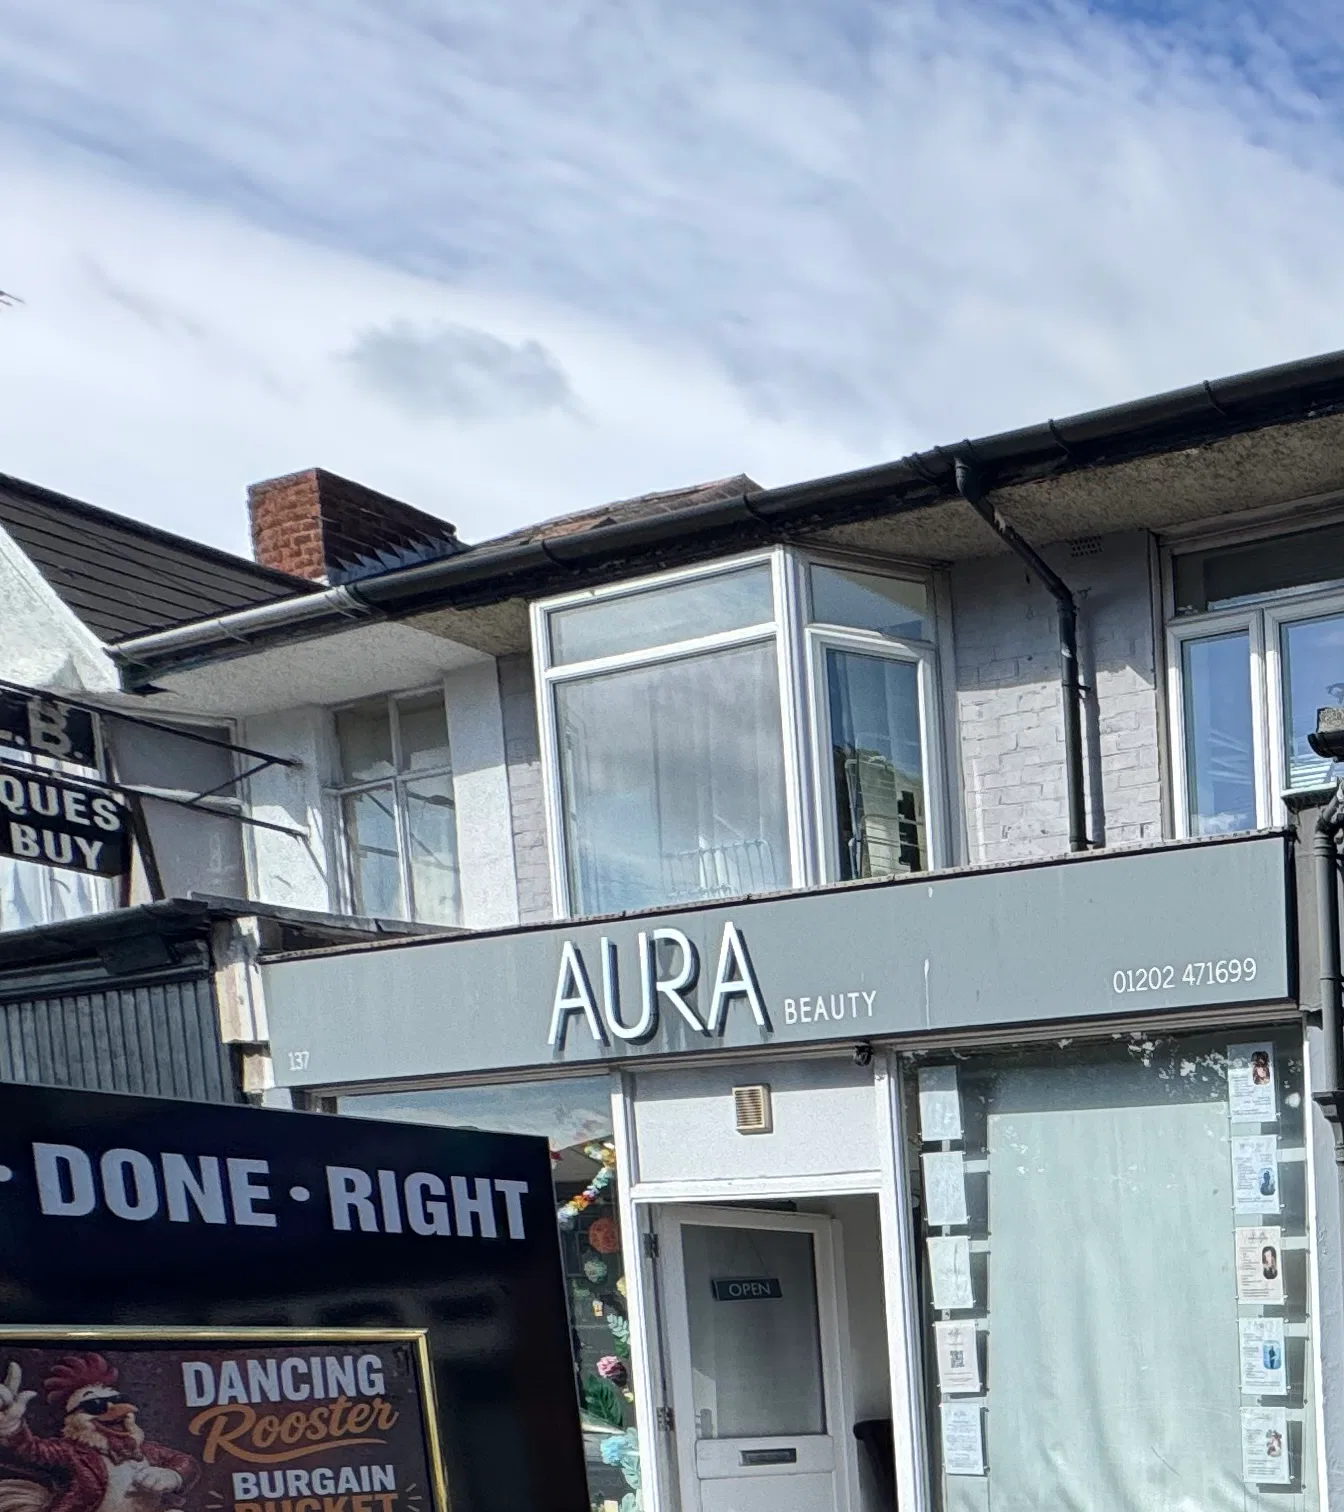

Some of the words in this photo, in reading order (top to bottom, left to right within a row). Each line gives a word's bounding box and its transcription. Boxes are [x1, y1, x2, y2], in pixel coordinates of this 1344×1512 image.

[9, 821, 104, 871] BUY
[547, 921, 768, 1045] AURA
[1113, 966, 1175, 994] 01202
[1182, 957, 1257, 986] 471699
[784, 990, 877, 1025] BEAUTY
[288, 1051, 310, 1071] 137
[32, 1142, 277, 1227] DONE
[325, 1165, 529, 1239] RIGHT
[728, 1282, 772, 1297] OPEN
[181, 1354, 386, 1408] DANCING
[188, 1395, 399, 1463] Rooster
[232, 1465, 396, 1500] BURGAIN
